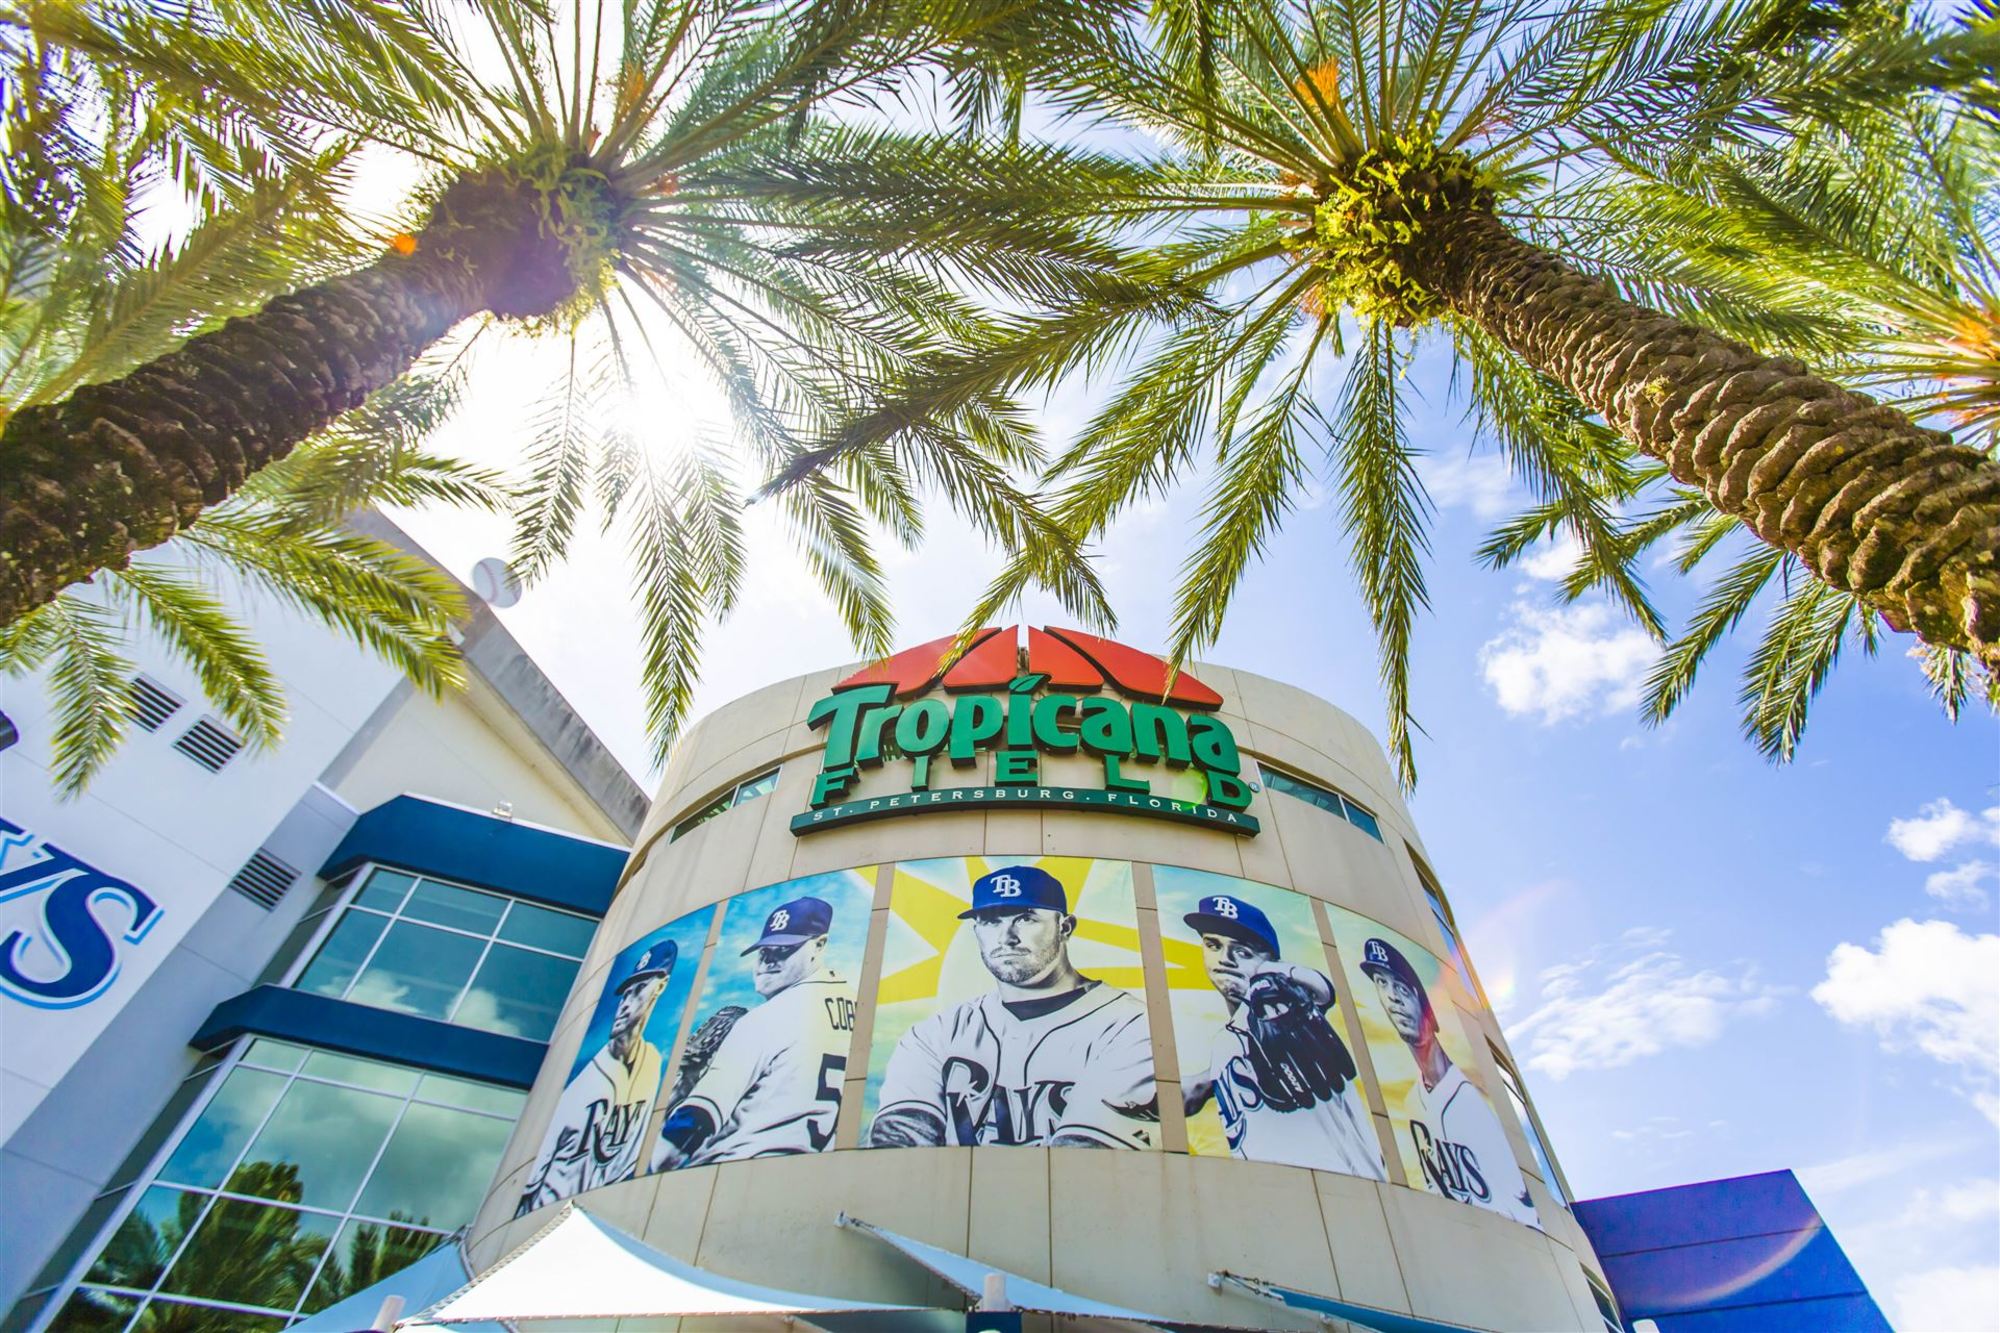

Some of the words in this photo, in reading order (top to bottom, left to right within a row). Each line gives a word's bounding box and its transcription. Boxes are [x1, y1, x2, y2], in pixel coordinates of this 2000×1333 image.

[807, 674, 1241, 777] Tropicana
[810, 751, 1253, 812] FIELD
[813, 807, 853, 822] ST.
[1107, 793, 1239, 823] FLORIDA
[990, 874, 1022, 898] TB
[1212, 896, 1238, 919] TB
[824, 997, 858, 1032] COB
[569, 1098, 646, 1165] RAY
[1409, 1119, 1492, 1205] RAYS
